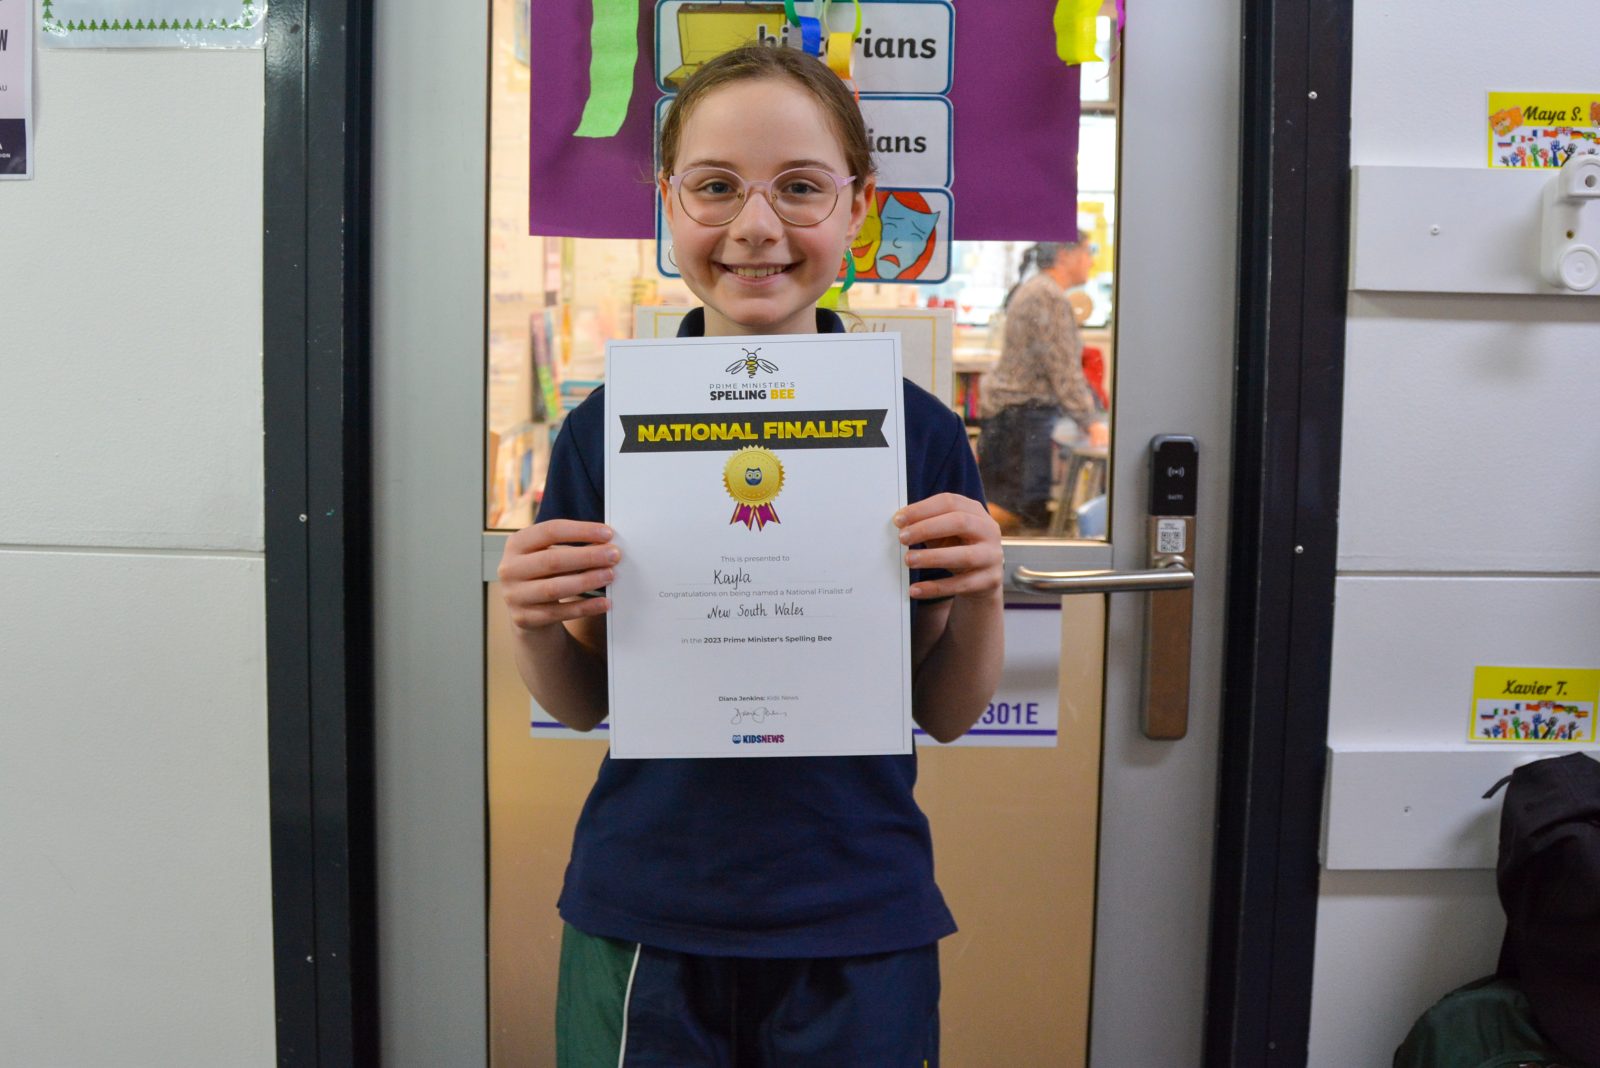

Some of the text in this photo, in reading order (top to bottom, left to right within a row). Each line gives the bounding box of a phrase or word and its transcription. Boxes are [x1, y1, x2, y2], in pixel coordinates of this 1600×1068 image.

[758, 25, 936, 58] hiians
[1523, 105, 1582, 125] Maya S.
[867, 128, 926, 153] ians
[741, 381, 795, 389] MINISTER'S
[710, 388, 795, 401] SPELLING BEE
[637, 419, 868, 442] NATIONAL FINALIST
[720, 555, 735, 563] This
[744, 555, 780, 564] presented
[713, 567, 752, 590] Kayla
[658, 590, 717, 599] Congratulations
[729, 589, 751, 598] being
[752, 589, 778, 597] named
[786, 588, 816, 596] National
[818, 587, 844, 595] Finalist
[845, 587, 854, 595] of
[707, 601, 804, 619] New South Wales
[681, 637, 689, 645] in
[689, 637, 703, 645] the
[723, 636, 746, 644] Prime
[747, 635, 784, 643] Minister's
[785, 634, 816, 644] Spelling
[817, 635, 833, 643] Bee
[1502, 679, 1568, 696] Xavier T.
[980, 702, 1039, 725] 301E
[742, 734, 785, 745] KIDSNEWS
